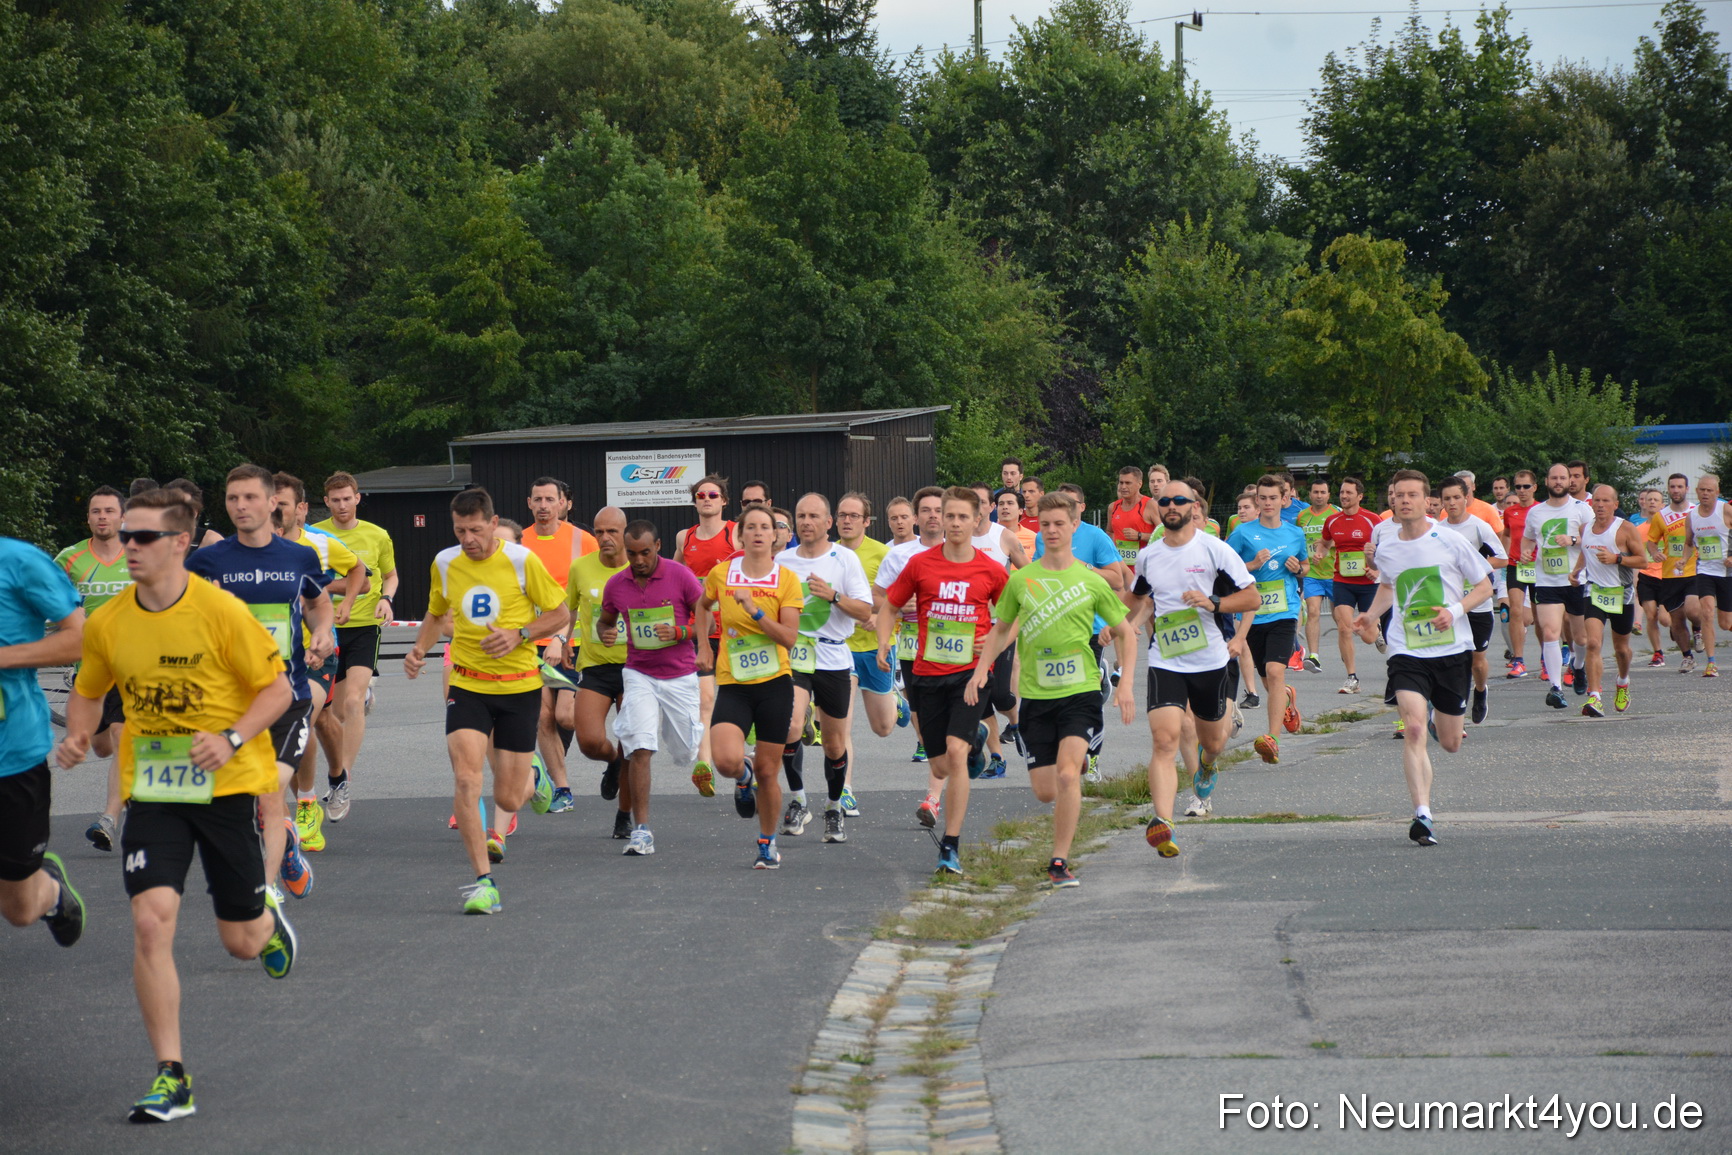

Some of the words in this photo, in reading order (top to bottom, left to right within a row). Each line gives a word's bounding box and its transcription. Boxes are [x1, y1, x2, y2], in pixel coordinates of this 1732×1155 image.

[607, 453, 653, 461] Kunsteisbahnen
[656, 452, 702, 460] Bandensysteme
[629, 466, 667, 479] AST
[1668, 522, 1685, 533] MAX
[1702, 545, 1717, 554] 591
[1346, 561, 1358, 570] 32
[1546, 557, 1563, 568] 100
[223, 572, 255, 583] EURO
[264, 571, 296, 582] POLES
[752, 588, 779, 599] BÖGL
[471, 593, 492, 619] B
[1597, 594, 1616, 607] 581
[931, 601, 976, 615] MEIER
[1020, 581, 1088, 637] BURKHARDT
[926, 610, 957, 622] Running
[957, 615, 979, 623] Team
[1161, 624, 1200, 647] 1439
[1413, 621, 1444, 637] 11
[935, 636, 964, 653] 946
[158, 655, 189, 665] swn
[739, 650, 770, 669] 896
[791, 646, 808, 661] 03
[1044, 660, 1076, 677] 205
[142, 764, 207, 788] 1478
[125, 849, 147, 874] 44
